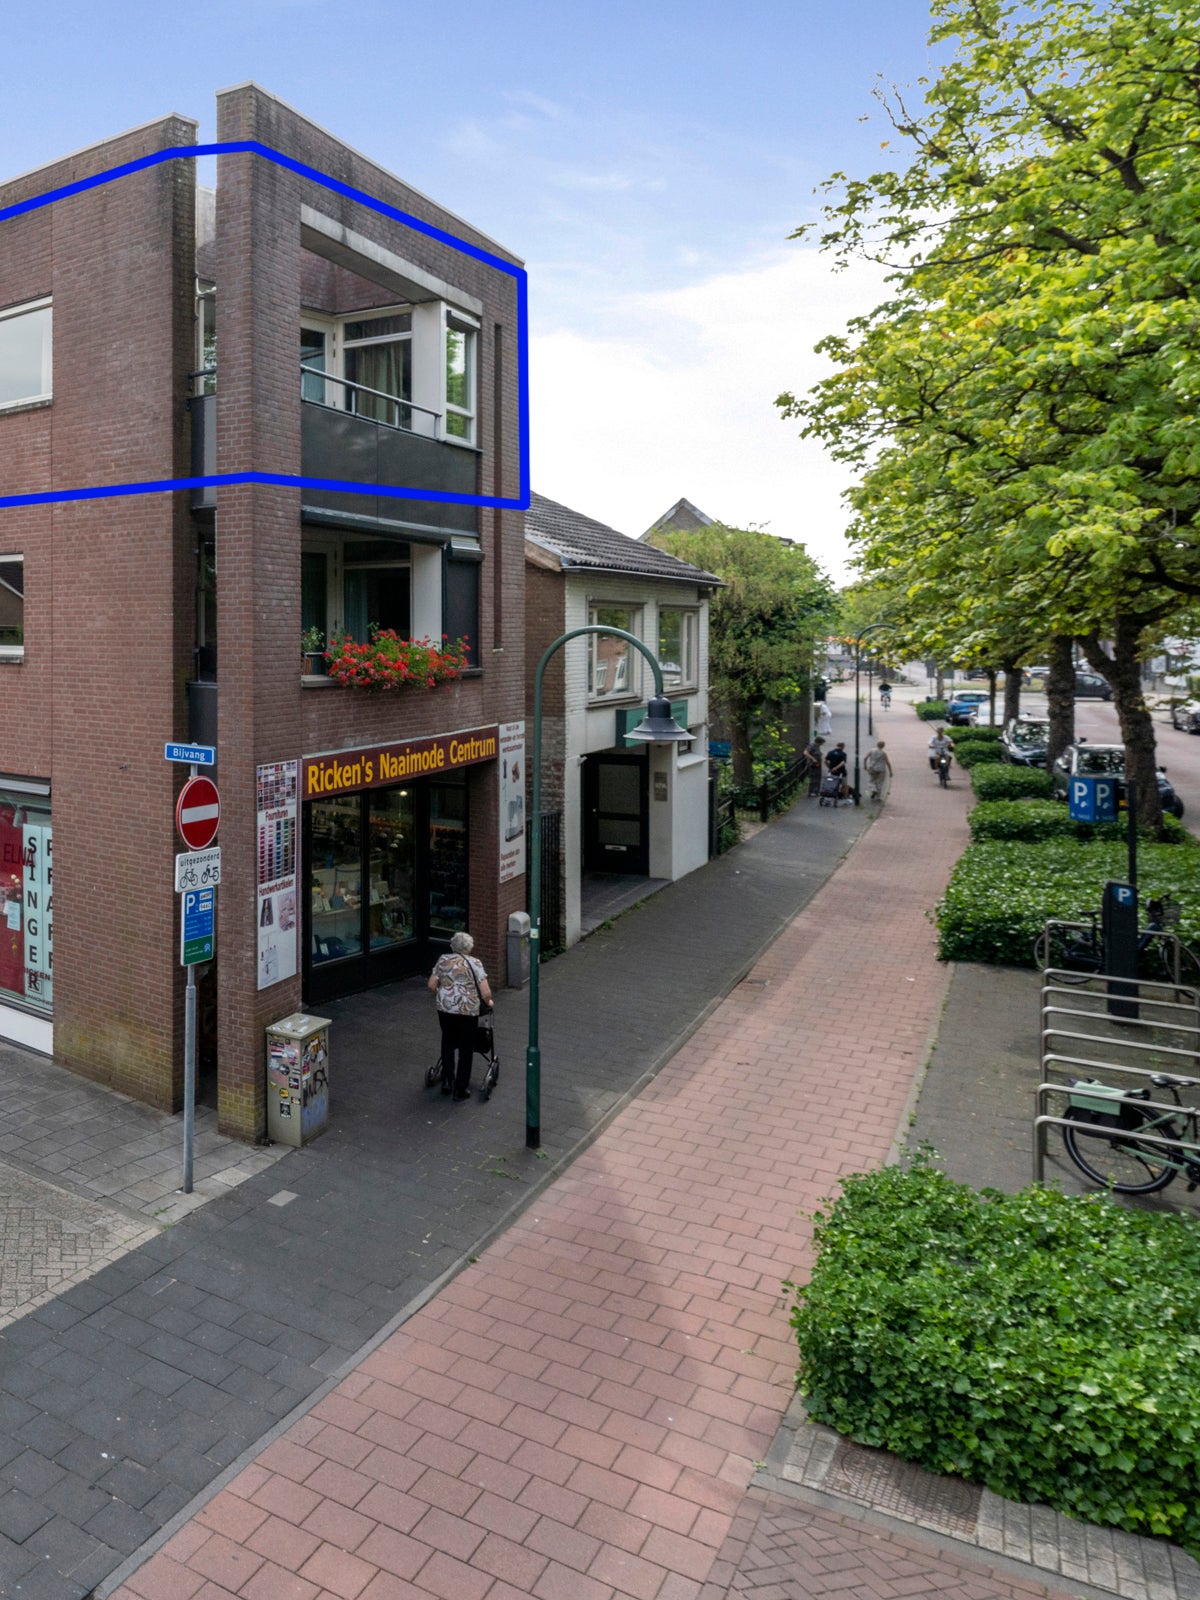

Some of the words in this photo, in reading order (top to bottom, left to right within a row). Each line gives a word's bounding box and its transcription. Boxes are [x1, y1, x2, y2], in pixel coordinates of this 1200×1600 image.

[172, 747, 205, 762] Bijvang
[307, 755, 373, 795] Ricken's
[379, 743, 445, 779] Naaimode
[450, 736, 496, 764] Centrum
[1074, 781, 1088, 804] P
[1096, 783, 1110, 806] P
[3, 843, 36, 867] ELNA
[179, 852, 220, 868] uitgezonderd
[186, 894, 196, 915] P
[1118, 888, 1131, 902] P
[27, 836, 39, 991] SINGER
[23, 967, 51, 981] ICKEN
